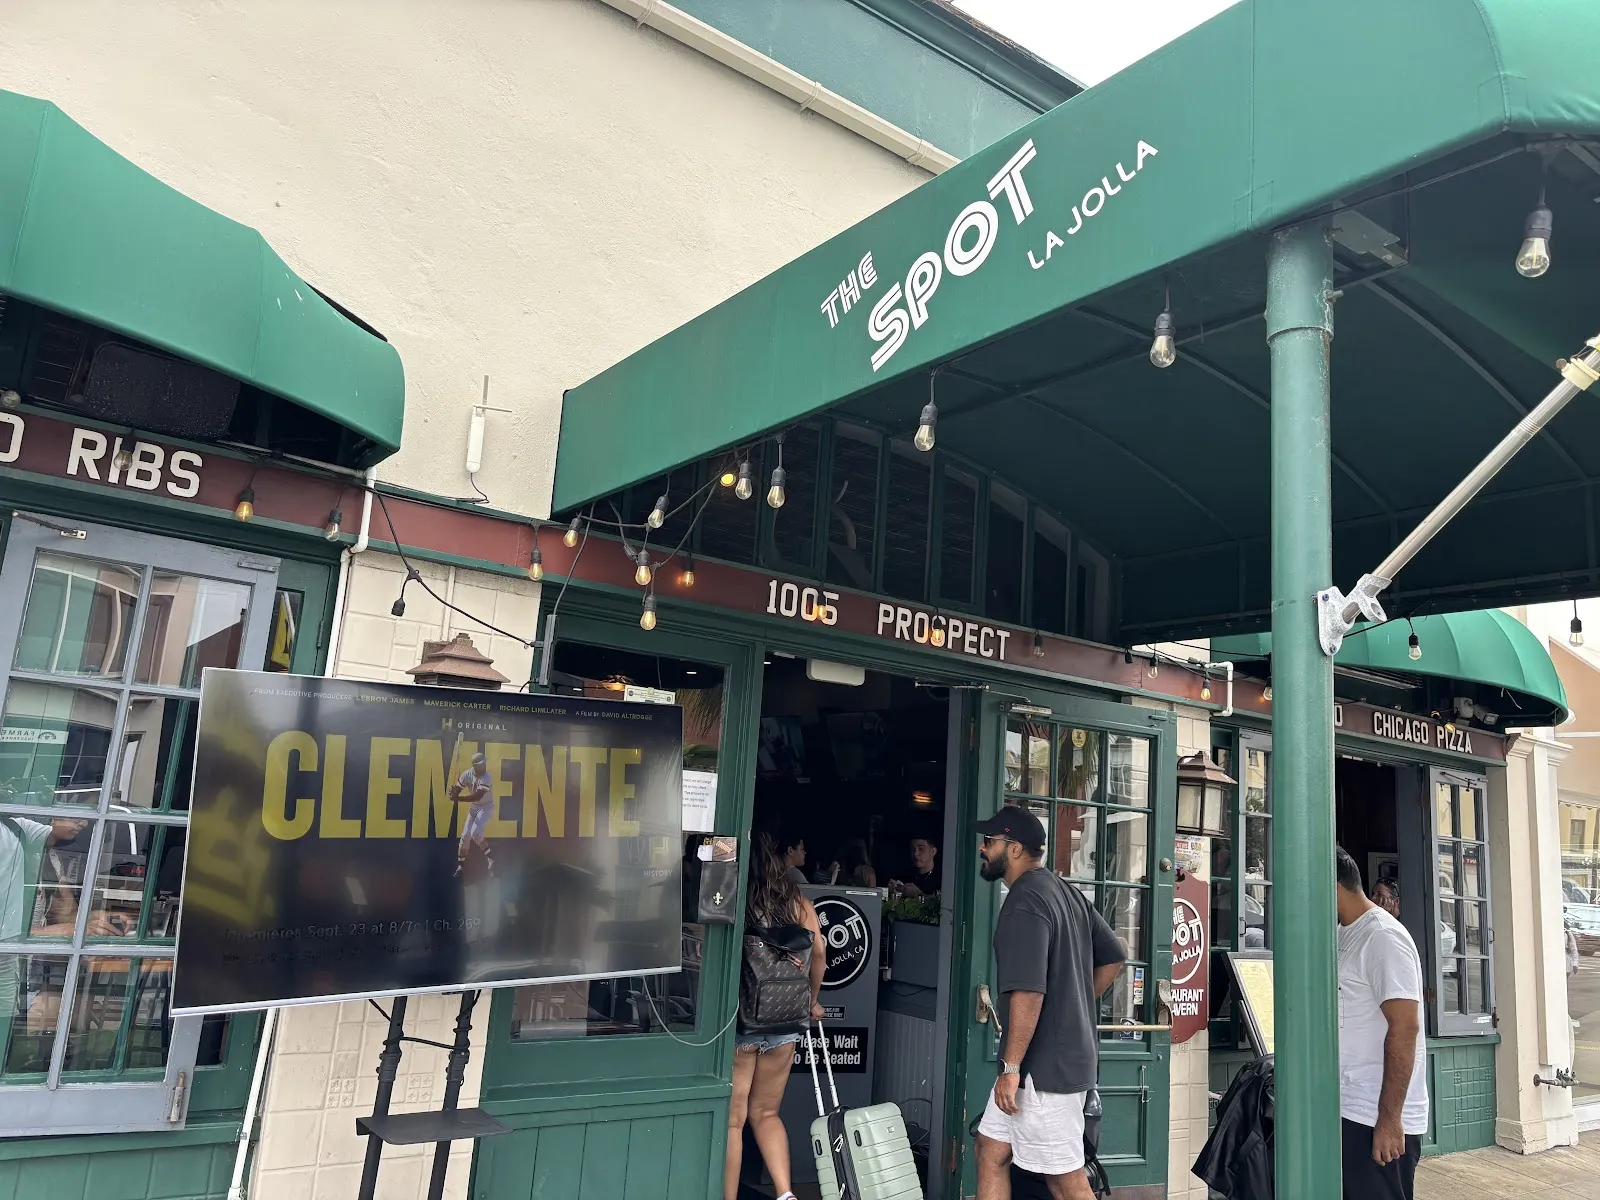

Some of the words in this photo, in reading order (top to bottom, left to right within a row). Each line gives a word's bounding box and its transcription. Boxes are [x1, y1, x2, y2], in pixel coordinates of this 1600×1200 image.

[1026, 230, 1065, 270] LA
[1066, 139, 1159, 235] JOLLA
[867, 138, 1037, 373] SPOT
[820, 250, 878, 329] THE
[0, 411, 25, 463] D
[66, 427, 204, 499] RIBS
[766, 579, 840, 626] 1005
[876, 602, 1011, 661] PROSPECT
[356, 695, 387, 703] LEBRON
[389, 697, 415, 705] JAMES
[423, 699, 461, 708] MAVERICK
[463, 701, 491, 710] CARTER
[500, 704, 530, 713] RICHARD
[531, 706, 567, 715] LINKLATER
[601, 711, 620, 719] DAVID
[621, 712, 653, 721] ALTROGGE
[457, 722, 507, 731] ORIGINAL
[1334, 704, 1343, 727] D
[1373, 711, 1429, 745] CHICAGO
[1436, 725, 1473, 754] PIZZA
[261, 730, 642, 841] CLEMENTE
[643, 869, 673, 877] HISTORY
[1172, 905, 1184, 925] HE
[350, 923, 366, 936] 23
[371, 922, 384, 935] at
[821, 914, 861, 949] OT
[1172, 918, 1200, 946] OT
[831, 951, 855, 967] JOLLA,
[854, 945, 865, 954] CA
[1172, 954, 1179, 966] A
[1179, 945, 1200, 962] JOLLA
[1171, 988, 1204, 1002] AURANT
[1171, 1002, 1199, 1017] AVERN
[833, 1034, 859, 1049] Wait
[794, 1050, 801, 1065] o
[804, 1050, 820, 1065] Be
